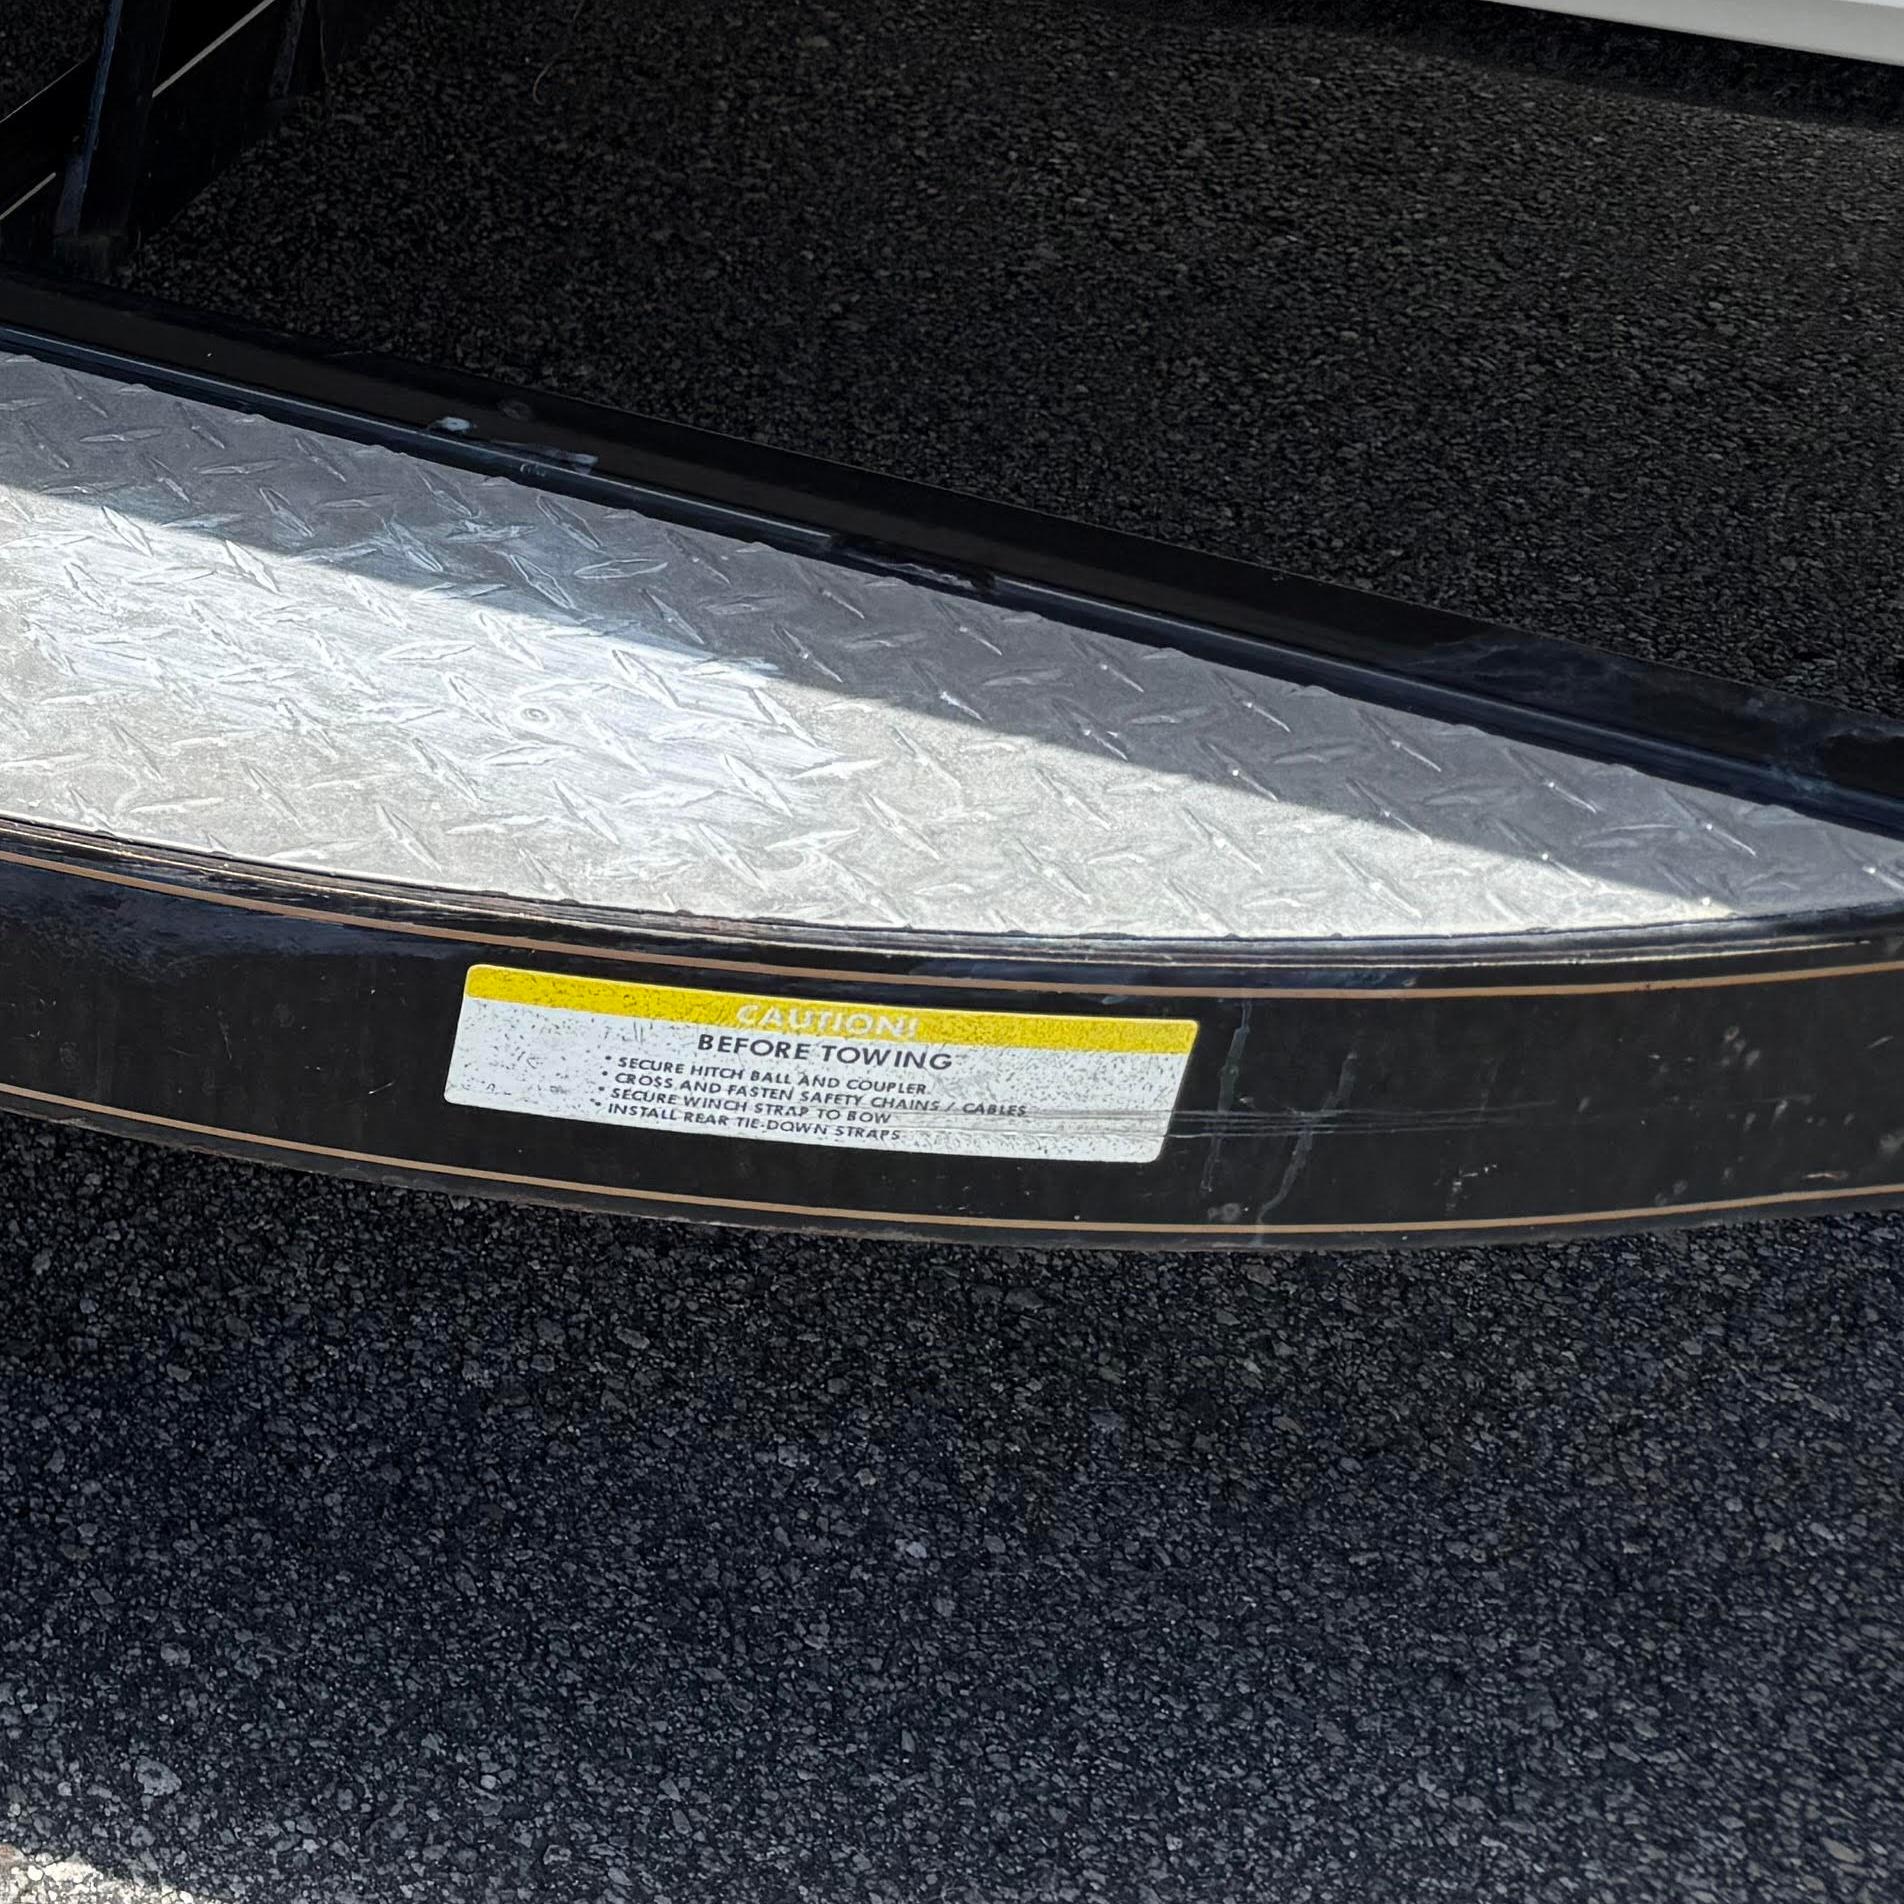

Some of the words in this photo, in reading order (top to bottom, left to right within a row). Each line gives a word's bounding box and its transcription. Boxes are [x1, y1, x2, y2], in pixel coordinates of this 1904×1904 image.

[735, 1004, 921, 1038] CAUTION!
[697, 1033, 811, 1061] BEFORE
[821, 1044, 953, 1070] TOWING
[617, 1056, 685, 1074] SECURE
[690, 1064, 744, 1080] HITCH
[750, 1070, 792, 1085] BALL
[798, 1074, 840, 1089] AND
[846, 1078, 927, 1095] COUPLER
[611, 1088, 677, 1105] SECURE
[684, 1096, 747, 1112] WINCH
[754, 1102, 809, 1118] STRAP
[817, 1107, 840, 1121] TO
[847, 1111, 892, 1124] BOW
[615, 1072, 673, 1089] CROSS
[680, 1080, 721, 1094] AND
[728, 1084, 793, 1101] FASTEN
[800, 1091, 863, 1107] SAFETY
[871, 1096, 940, 1112] CHAINS
[962, 1102, 1026, 1117] CABLES
[608, 1103, 676, 1121] INSTALL
[684, 1112, 729, 1126] REAR
[736, 1117, 828, 1135] TIE-DOWN
[834, 1125, 901, 1140] STRAPS
